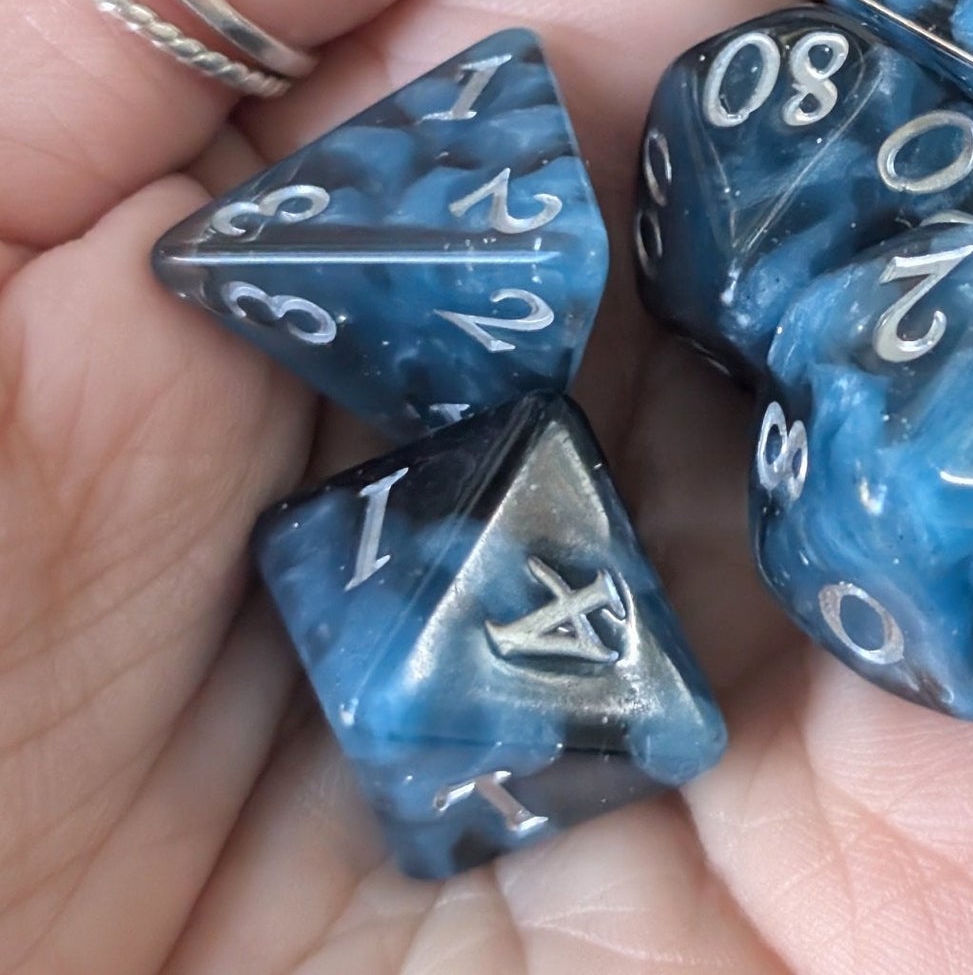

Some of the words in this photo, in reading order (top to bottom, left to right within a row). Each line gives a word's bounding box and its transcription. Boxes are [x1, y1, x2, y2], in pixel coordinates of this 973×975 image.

[420, 53, 512, 122] 1
[212, 184, 331, 237] 3
[448, 167, 562, 234] 2
[223, 280, 337, 346] 3
[434, 288, 554, 353] 2
[344, 467, 409, 592] 1
[484, 555, 626, 664] 4
[818, 582, 904, 664] 0
